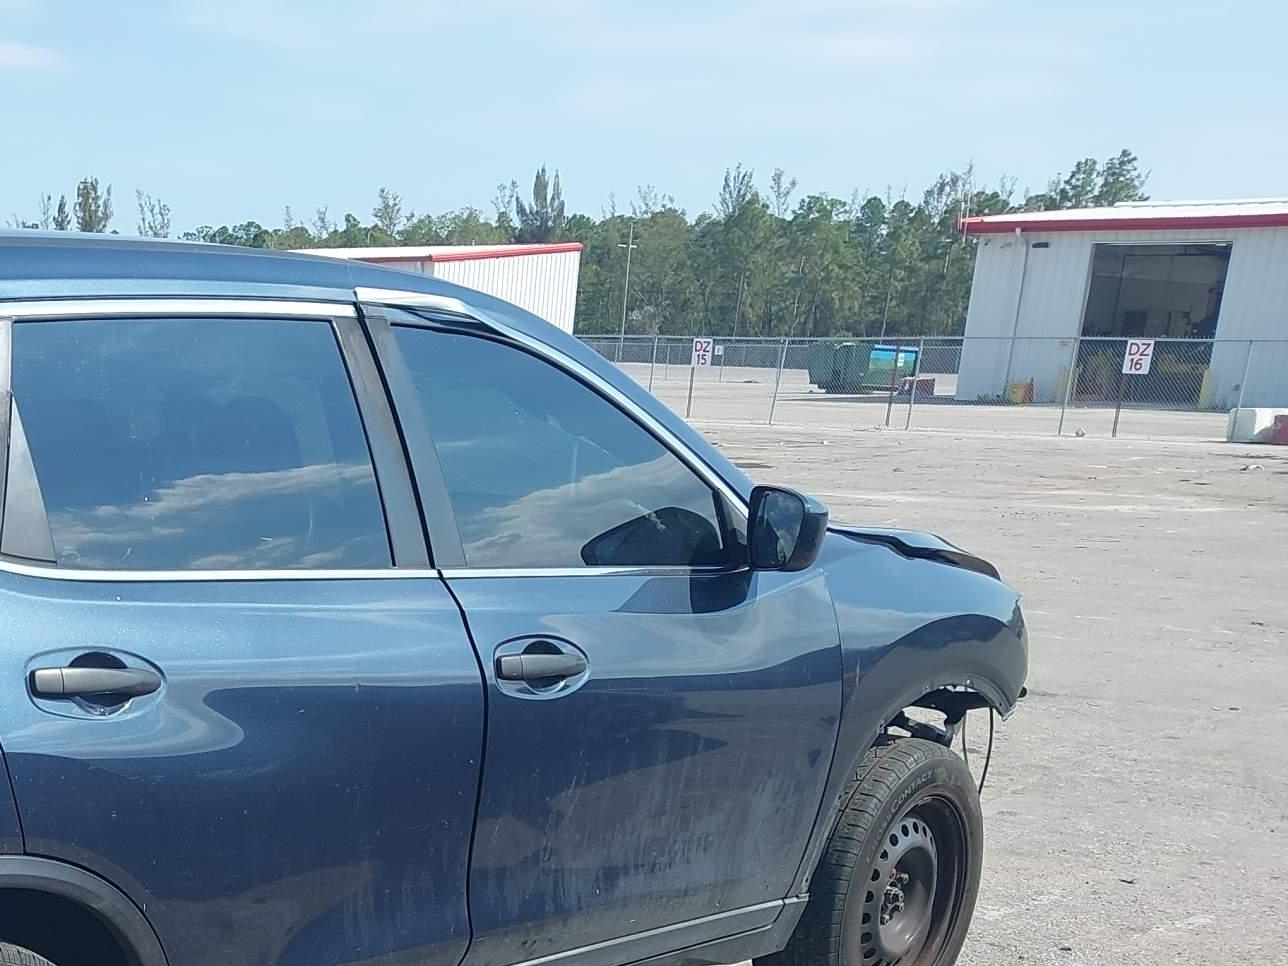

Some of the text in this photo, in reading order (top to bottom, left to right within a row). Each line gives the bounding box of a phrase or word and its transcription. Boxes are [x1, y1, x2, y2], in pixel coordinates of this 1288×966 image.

[694, 340, 711, 353] DZ
[1128, 342, 1152, 356] DZ
[696, 353, 707, 366] 15
[1128, 358, 1143, 371] 16
